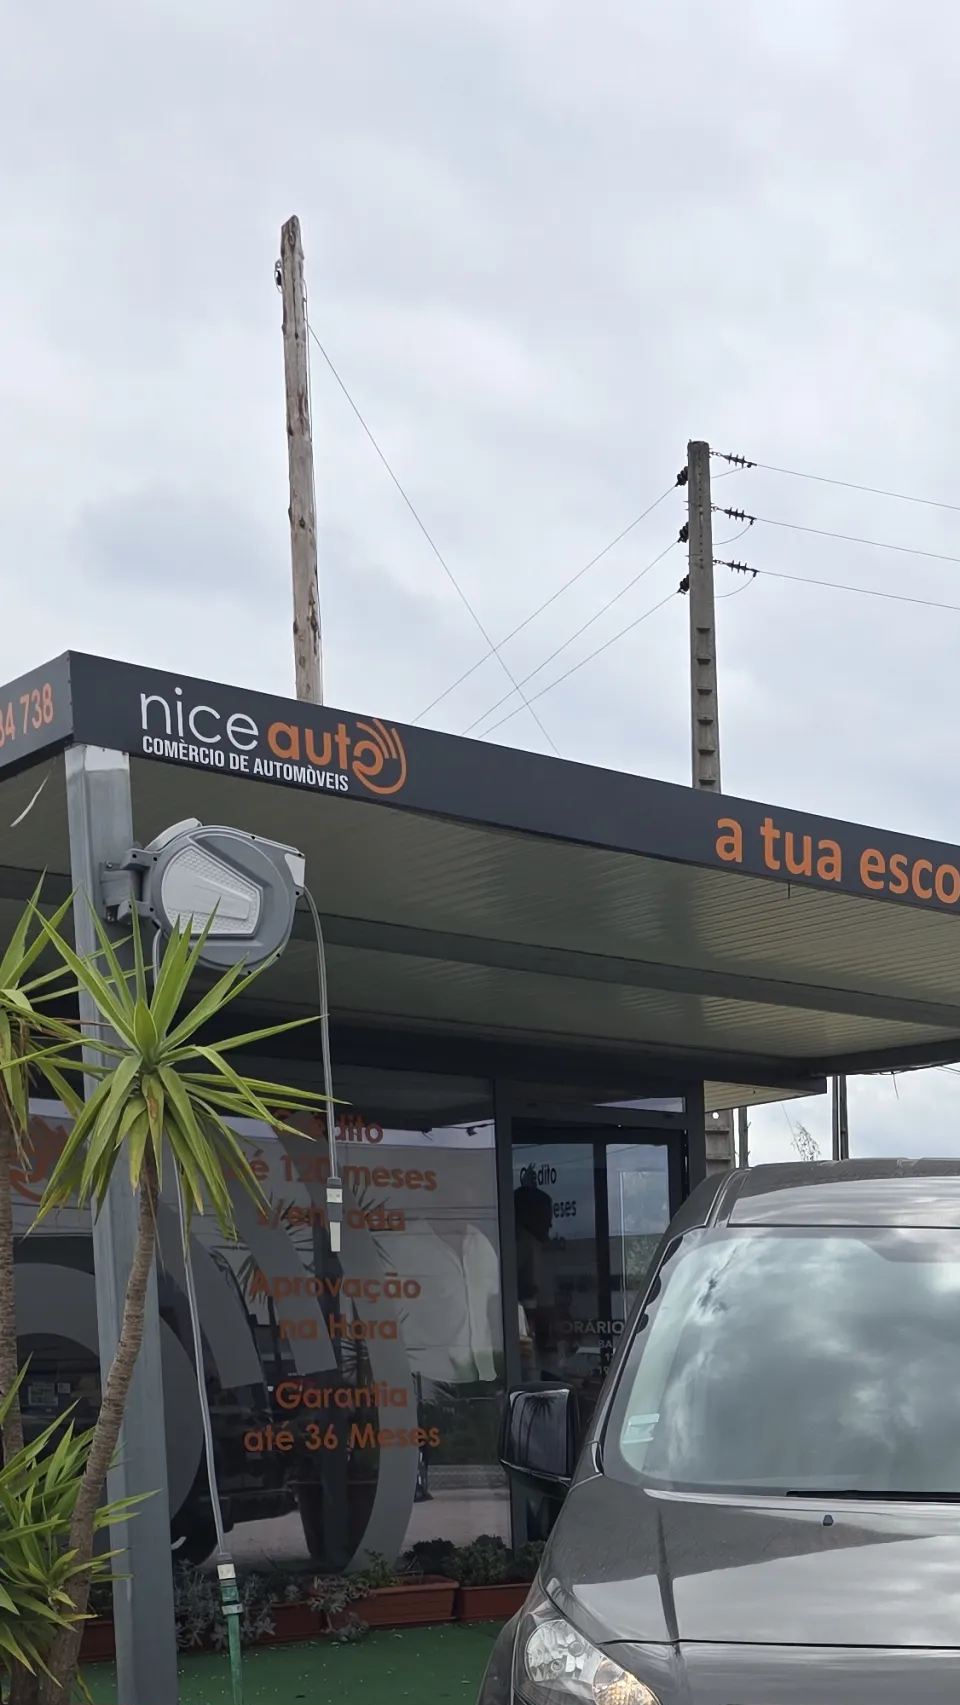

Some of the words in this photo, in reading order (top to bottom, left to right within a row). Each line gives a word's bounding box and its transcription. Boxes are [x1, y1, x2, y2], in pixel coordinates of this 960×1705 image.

[20, 683, 54, 734] 738
[229, 753, 250, 773] DE
[715, 818, 743, 863] a
[760, 817, 842, 882] tua
[342, 1165, 438, 1192] meses
[257, 1198, 406, 1232] s/enada
[249, 1271, 422, 1304] Aprovação
[280, 1319, 319, 1340] na
[328, 1313, 398, 1340] Hora
[550, 1319, 625, 1335] ORÁRIO
[275, 1380, 409, 1410] Garantia
[244, 1421, 295, 1452] até
[305, 1423, 339, 1450] 36
[350, 1422, 441, 1449] Meses
